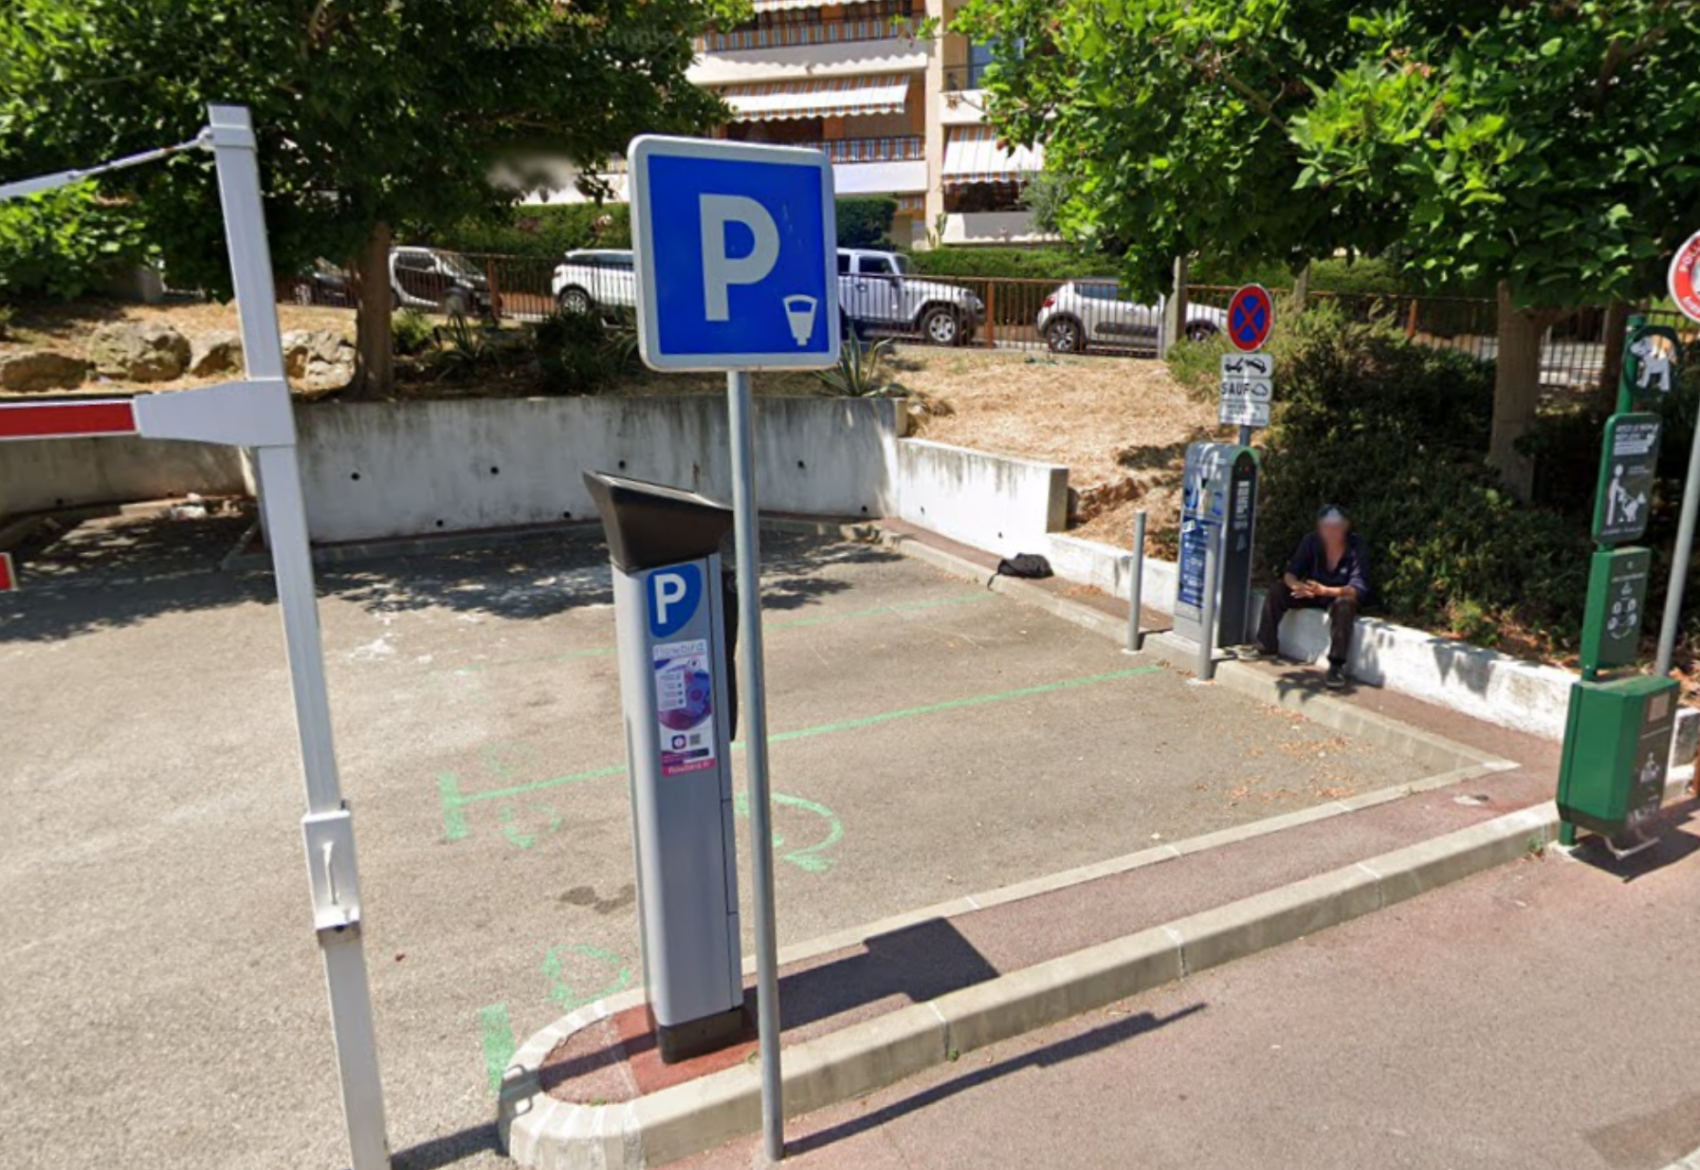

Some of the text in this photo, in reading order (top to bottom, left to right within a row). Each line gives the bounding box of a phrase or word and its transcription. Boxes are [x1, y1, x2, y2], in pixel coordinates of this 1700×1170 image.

[699, 193, 780, 321] P
[1221, 382, 1250, 396] SAUF
[654, 573, 687, 624] P
